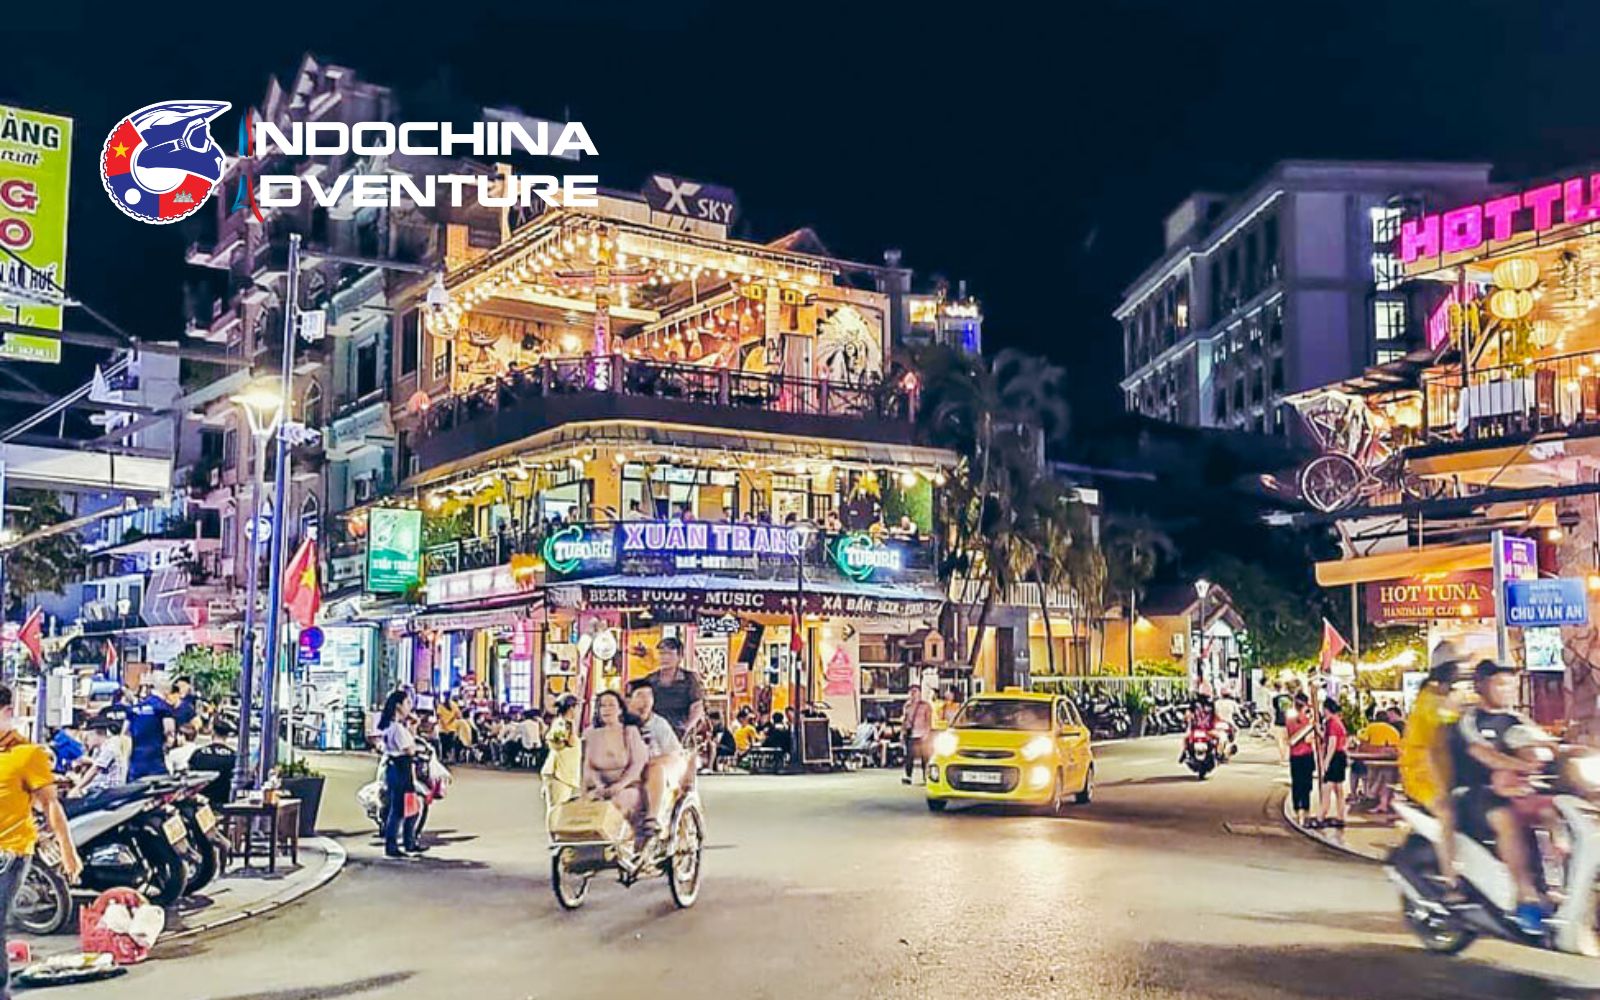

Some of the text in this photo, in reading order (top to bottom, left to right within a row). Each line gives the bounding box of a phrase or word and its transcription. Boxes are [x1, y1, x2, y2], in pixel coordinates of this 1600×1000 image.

[698, 198, 733, 223] SKY
[623, 518, 707, 550] XUÂN
[591, 588, 628, 602] BEER
[705, 591, 765, 607] MUSIC
[1380, 583, 1480, 604] HOT TUNA
[1510, 605, 1535, 620] CHU
[1565, 603, 1583, 619] AN
